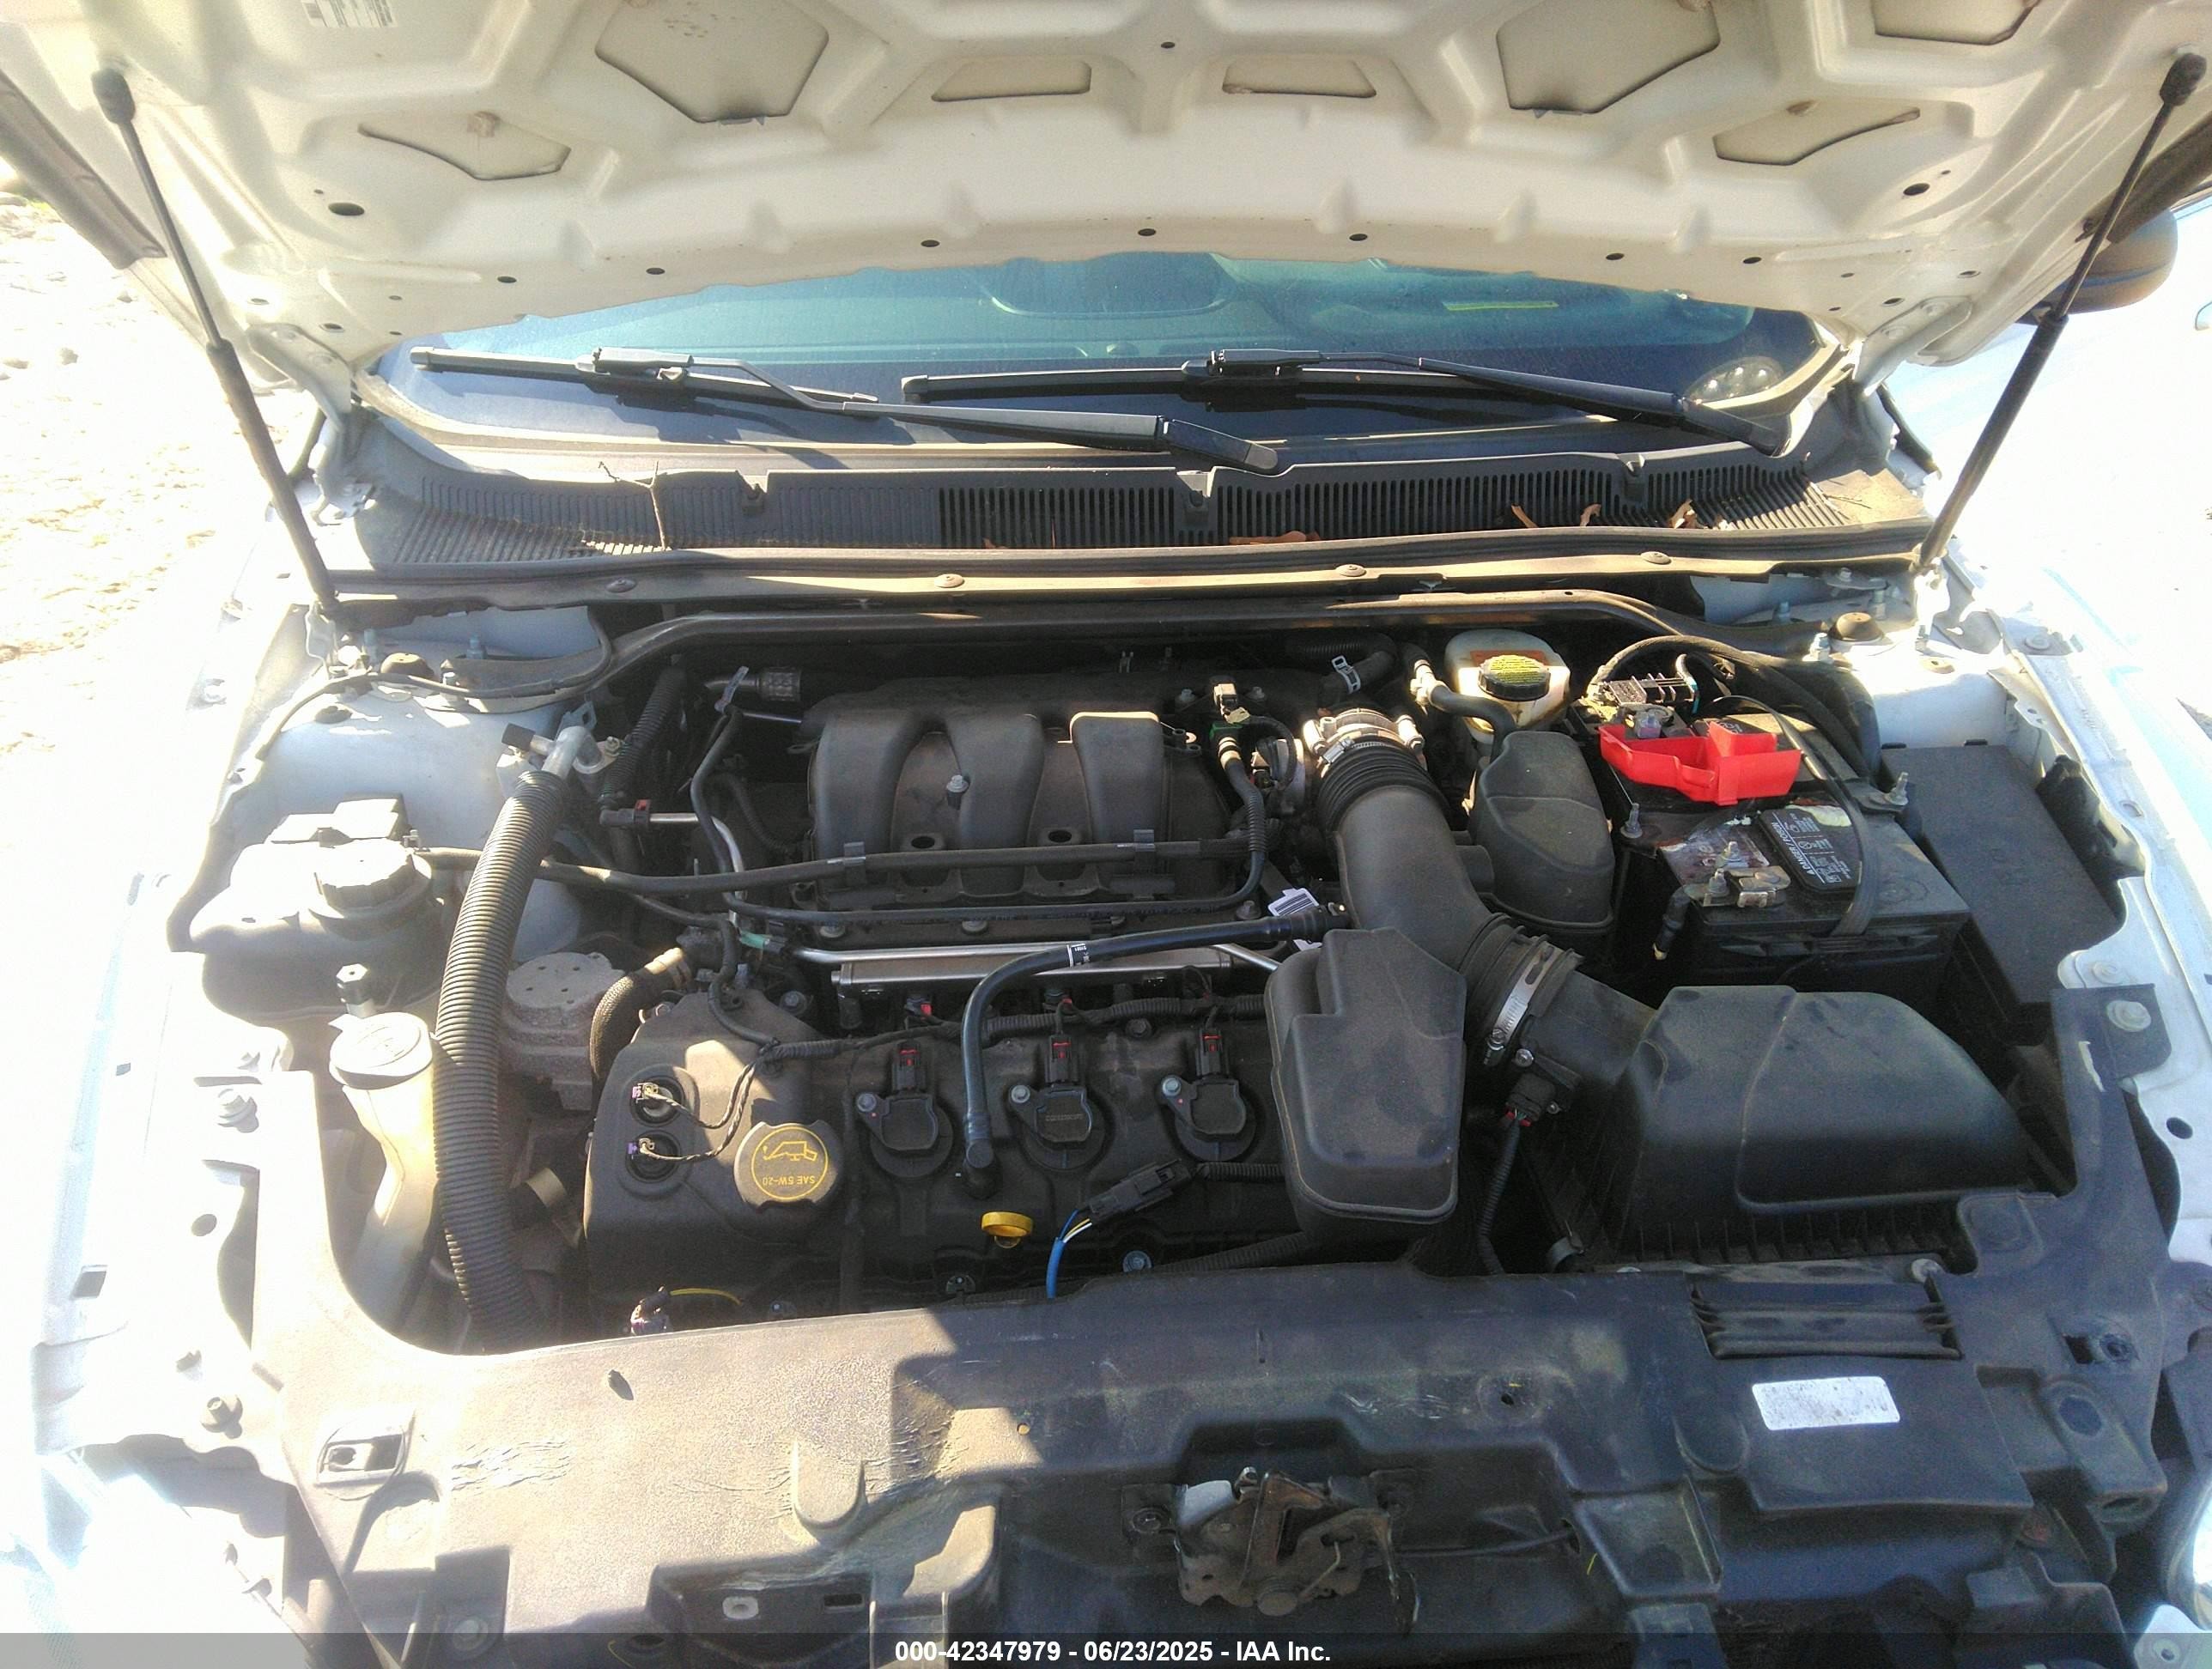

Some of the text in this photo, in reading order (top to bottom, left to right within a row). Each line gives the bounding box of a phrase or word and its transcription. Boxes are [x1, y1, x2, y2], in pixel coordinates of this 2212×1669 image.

[1771, 822, 1791, 842] POISON
[1789, 847, 1811, 870] DANGER
[762, 1175, 816, 1186] SAE 5W-20
